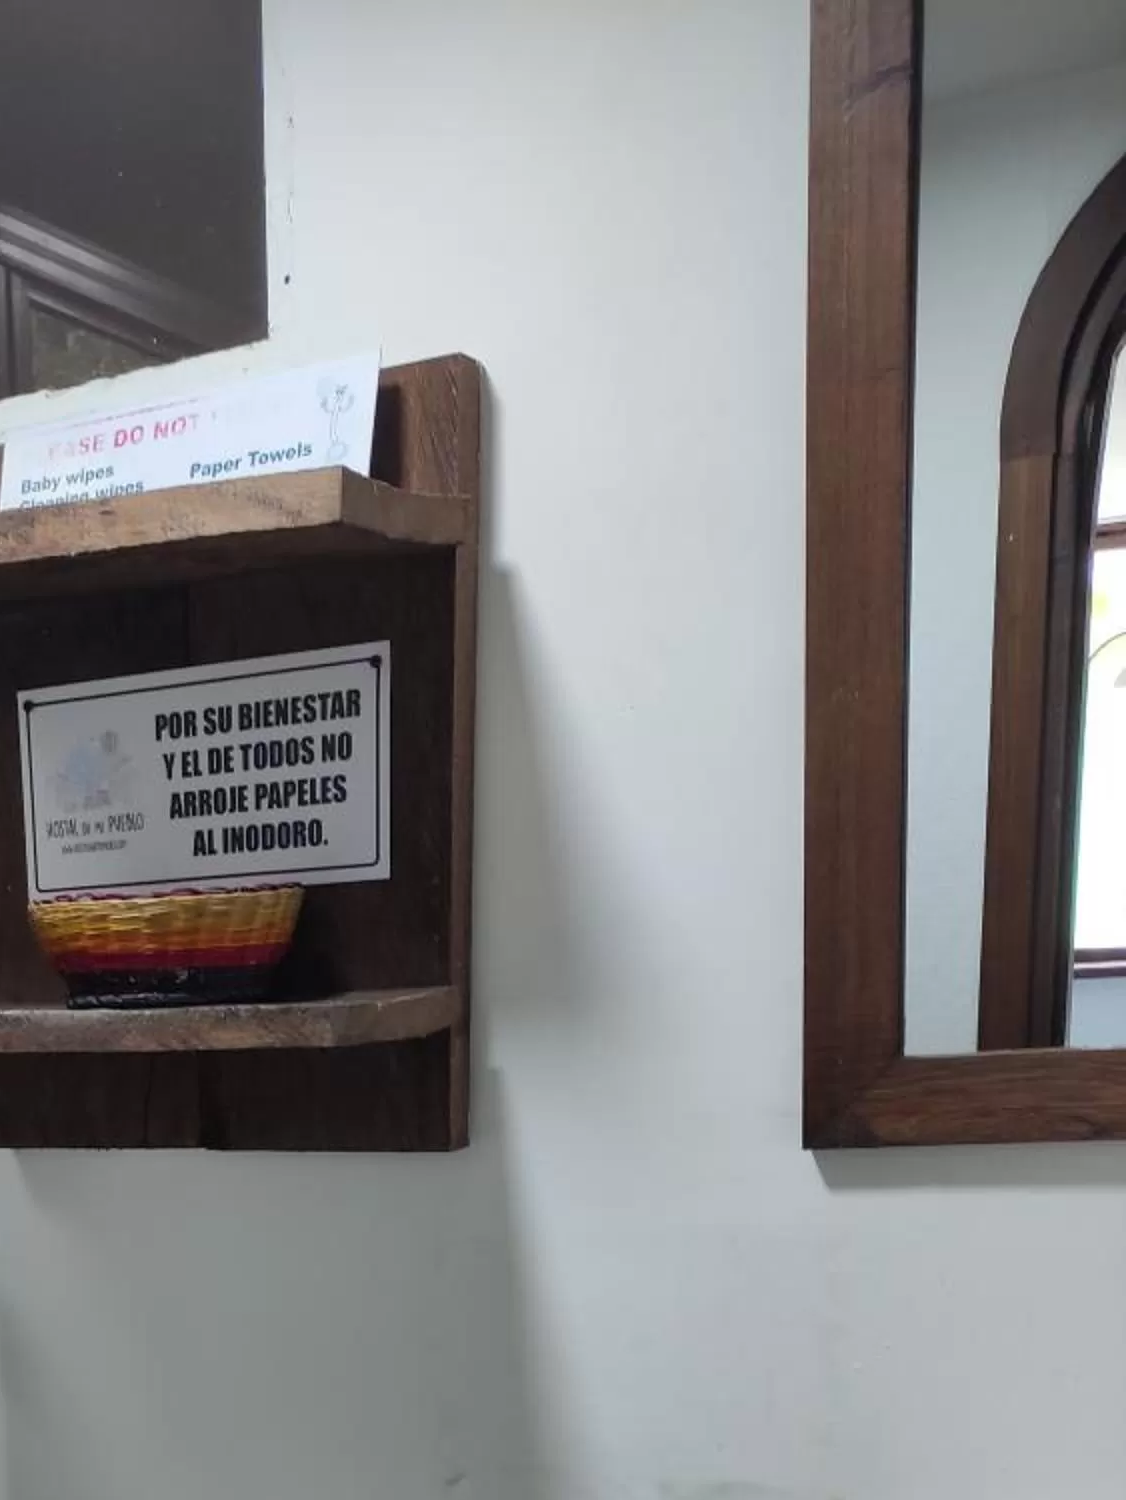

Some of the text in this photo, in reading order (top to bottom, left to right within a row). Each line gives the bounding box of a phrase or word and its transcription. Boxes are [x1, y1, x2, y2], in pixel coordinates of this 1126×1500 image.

[113, 426, 144, 449] DO
[153, 416, 199, 440] NOT
[21, 464, 115, 495] Baby wipes
[189, 441, 312, 479] Paper Towels
[155, 689, 361, 742] POR SU BIENESTAR
[163, 731, 353, 780] Y EL DE TODOS NO
[169, 774, 348, 820] ARROJE PAPELES
[193, 818, 329, 857] AL INODORO.
